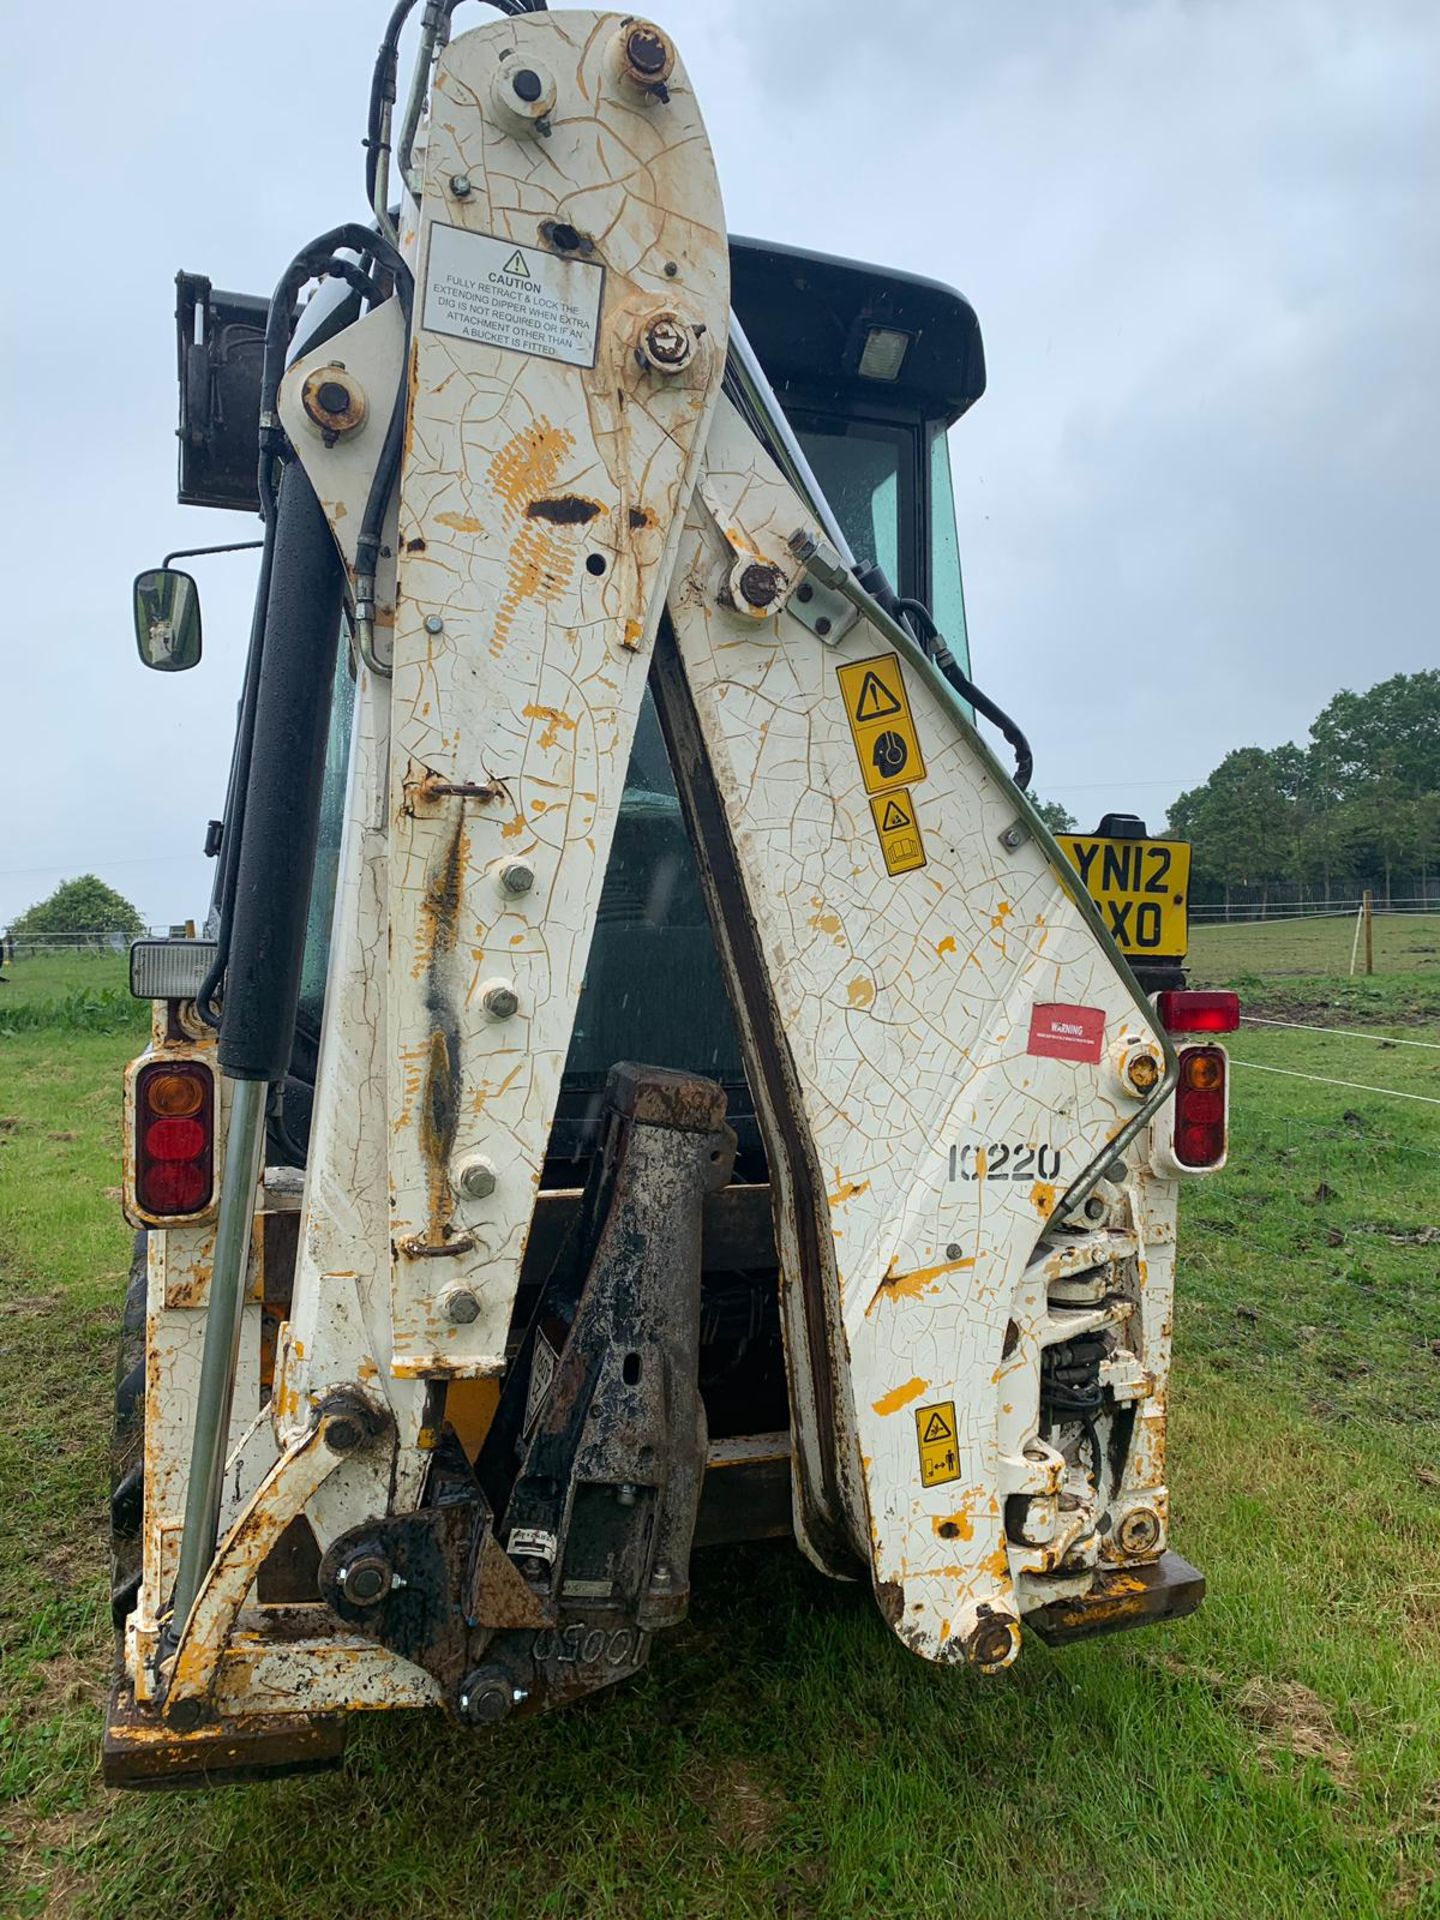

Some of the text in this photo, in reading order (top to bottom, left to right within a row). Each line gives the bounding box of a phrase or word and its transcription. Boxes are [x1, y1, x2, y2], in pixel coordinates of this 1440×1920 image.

[447, 275, 580, 315] FULLY RETRACT & LOCK THE
[488, 272, 541, 294] CAUTION
[433, 284, 590, 330] EXTENDING DIPPER WHEN EXTRA
[438, 297, 583, 339] DIG IS NOT REQUIRED OR IF AN
[447, 311, 572, 348] ATTACHMENT OTHER THAN
[462, 327, 469, 336] A
[471, 328, 509, 344] BUCKET
[512, 338, 520, 348] IS
[1073, 843, 1171, 894] YN12
[1093, 900, 1161, 948] XO
[1051, 1021, 1083, 1036] WARNING
